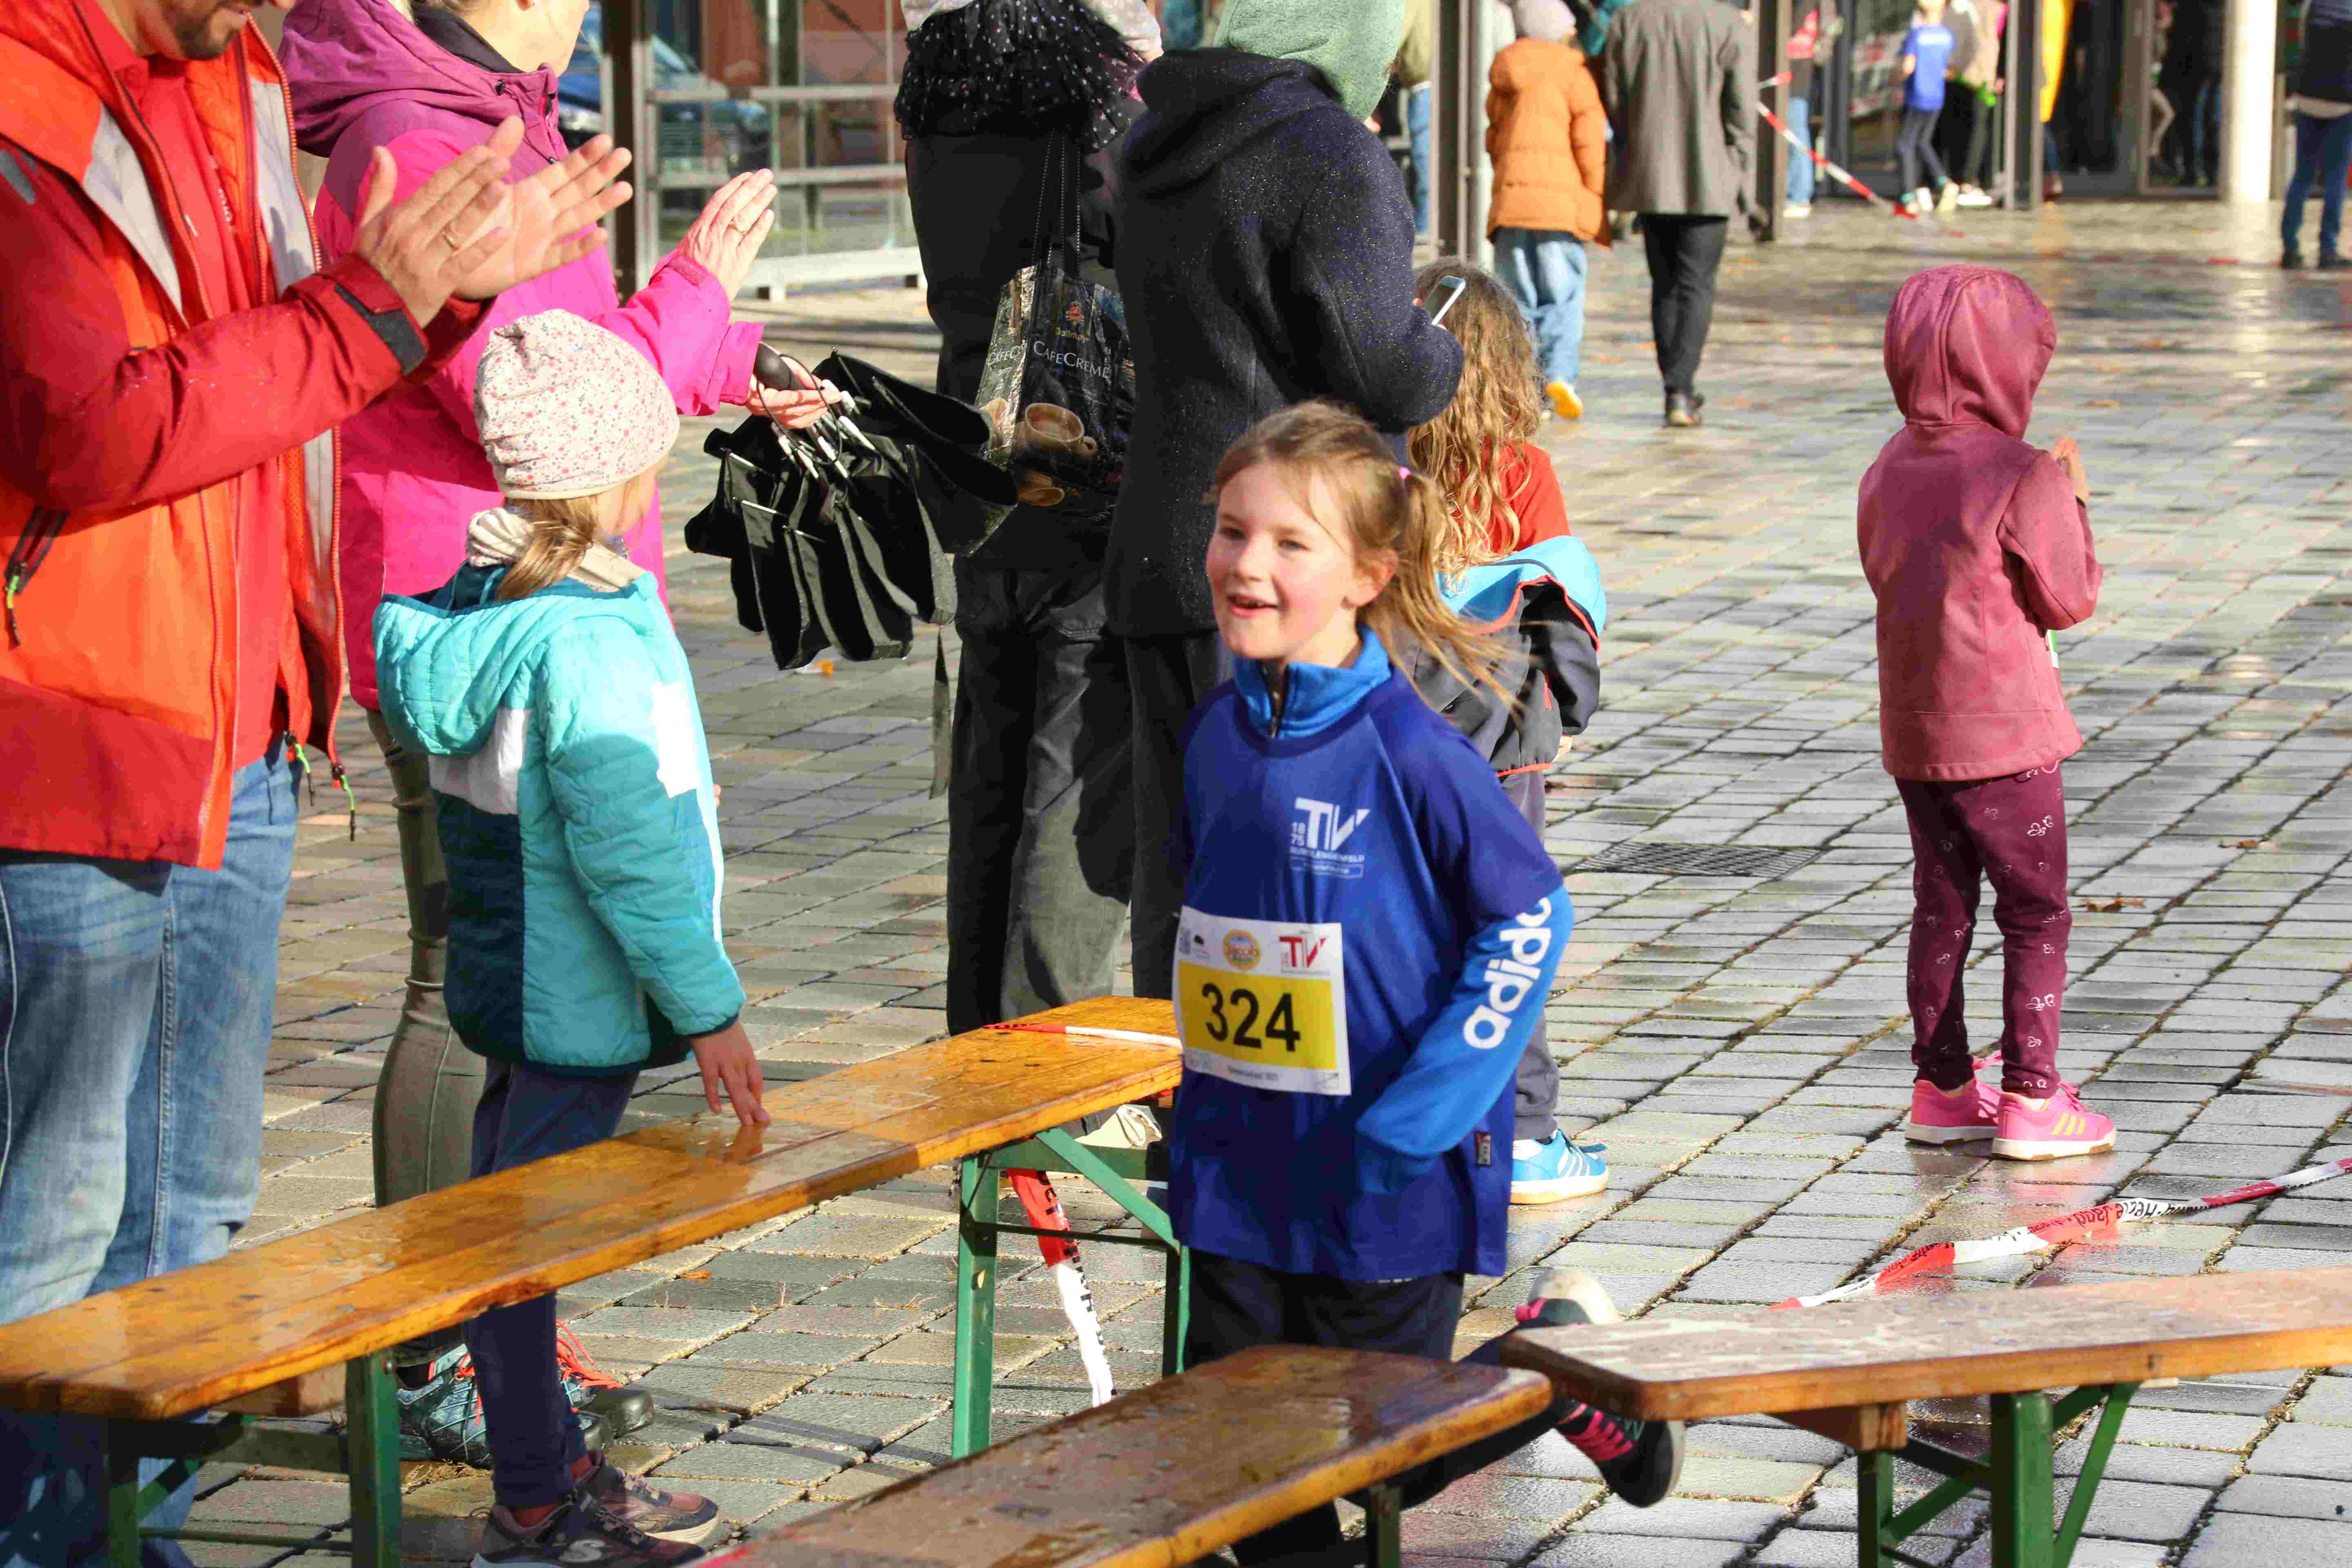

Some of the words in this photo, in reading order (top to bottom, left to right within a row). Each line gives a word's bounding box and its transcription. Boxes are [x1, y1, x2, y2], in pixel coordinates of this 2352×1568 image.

[1294, 797, 1371, 851] TV
[1278, 935, 1330, 968] TV
[1201, 982, 1301, 1053] 324
